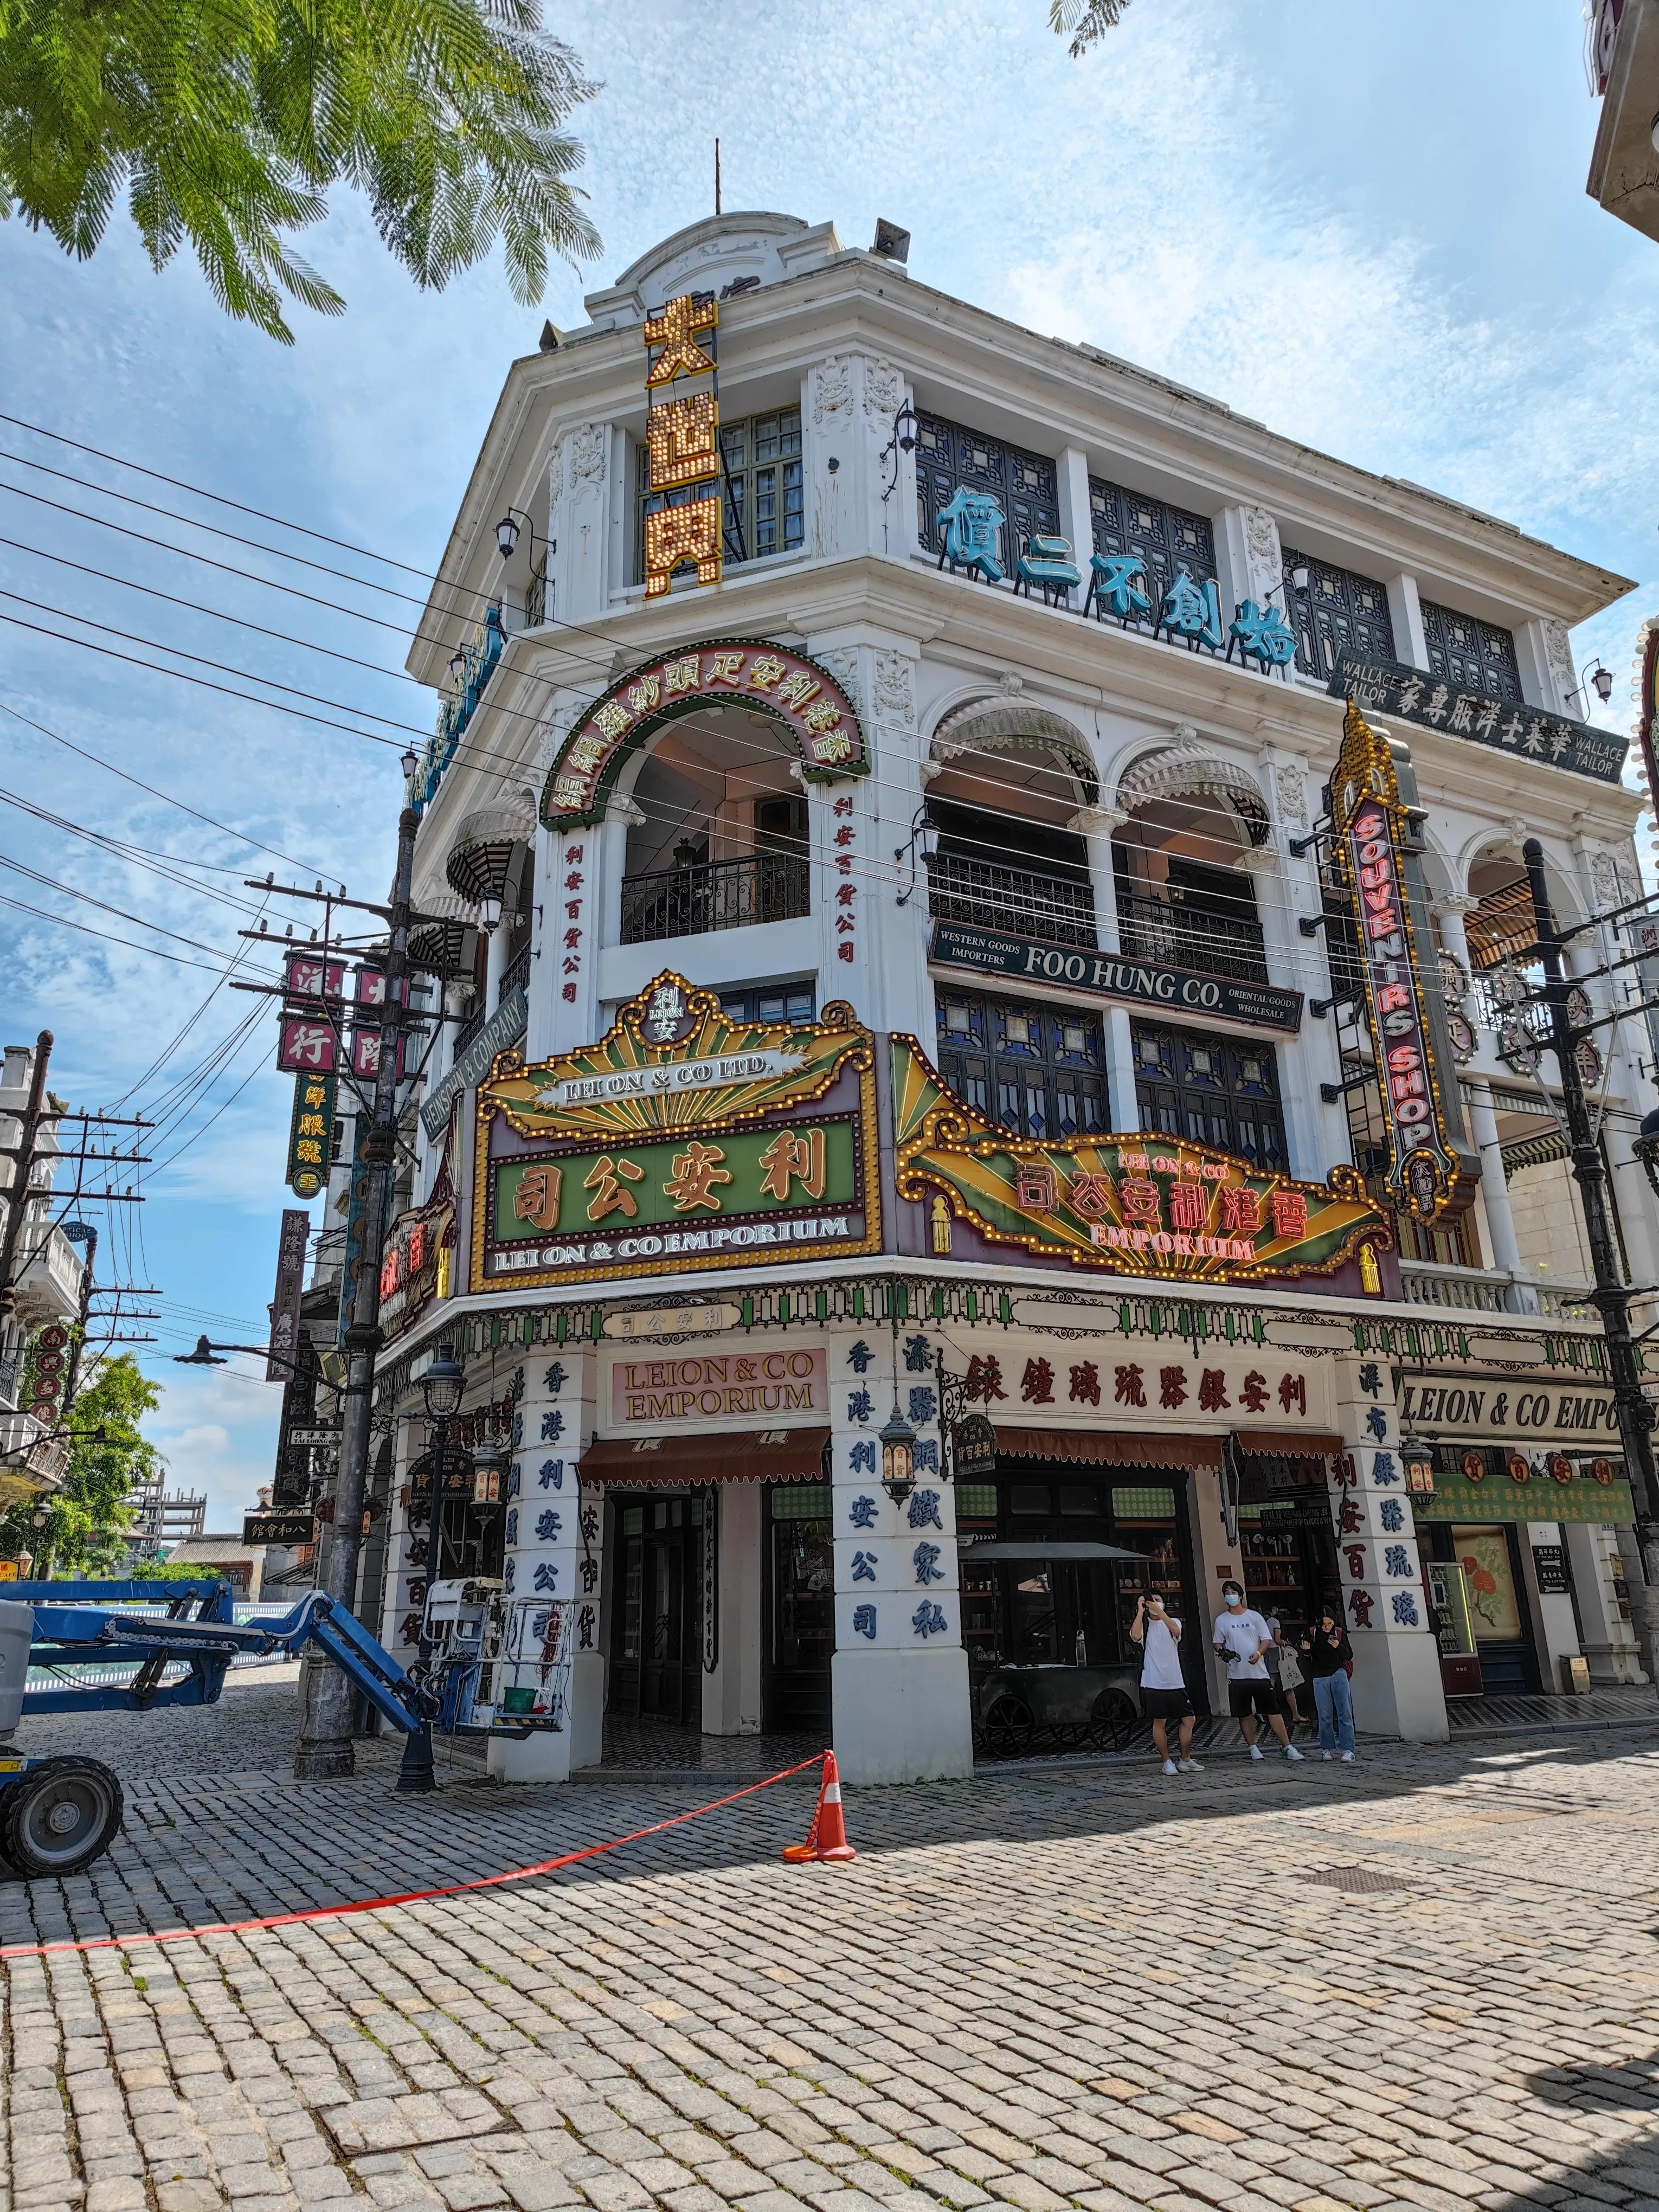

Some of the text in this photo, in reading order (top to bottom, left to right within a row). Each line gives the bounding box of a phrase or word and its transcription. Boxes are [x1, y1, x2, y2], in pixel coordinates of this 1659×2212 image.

[1342, 660, 1399, 690] WALLACE
[1342, 678, 1387, 704] TAILOR
[1576, 736, 1623, 763] WALLACE
[1576, 755, 1613, 774] TAILOR
[833, 796, 857, 963] 利安百貨公司
[562, 845, 584, 1003] 利安百貨公司
[941, 930, 1020, 954] WESTERN GOODS
[1355, 813, 1417, 1036] SOUVENIRS
[950, 947, 1005, 965] IMPORTERS
[1023, 946, 1224, 1009] FOO HUNG CO.
[649, 1007, 684, 1021] LEION
[1228, 988, 1296, 1008] ORIENTAL GOODS
[1237, 1003, 1285, 1020] WHOLESALE
[422, 1070, 465, 1134] HEINSOHN
[472, 996, 527, 1063] COMPANY
[563, 1054, 773, 1102] LEI ON & CO LTD.
[1388, 1045, 1432, 1153] SHOP
[1118, 1153, 1150, 1171] LEI
[1151, 1156, 1182, 1173] ON
[1201, 1163, 1230, 1180] CO
[495, 1216, 851, 1271] LEI ON & CO EMPORIUM
[1089, 1223, 1256, 1262] EMPORIUM
[625, 1352, 814, 1391] LEION & CO
[625, 1382, 814, 1420] EMPORIUM
[1401, 1386, 1486, 1427] LEION
[1490, 1392, 1509, 1426] &
[1516, 1394, 1549, 1428] CO
[846, 1340, 879, 1639] 香港利安公司
